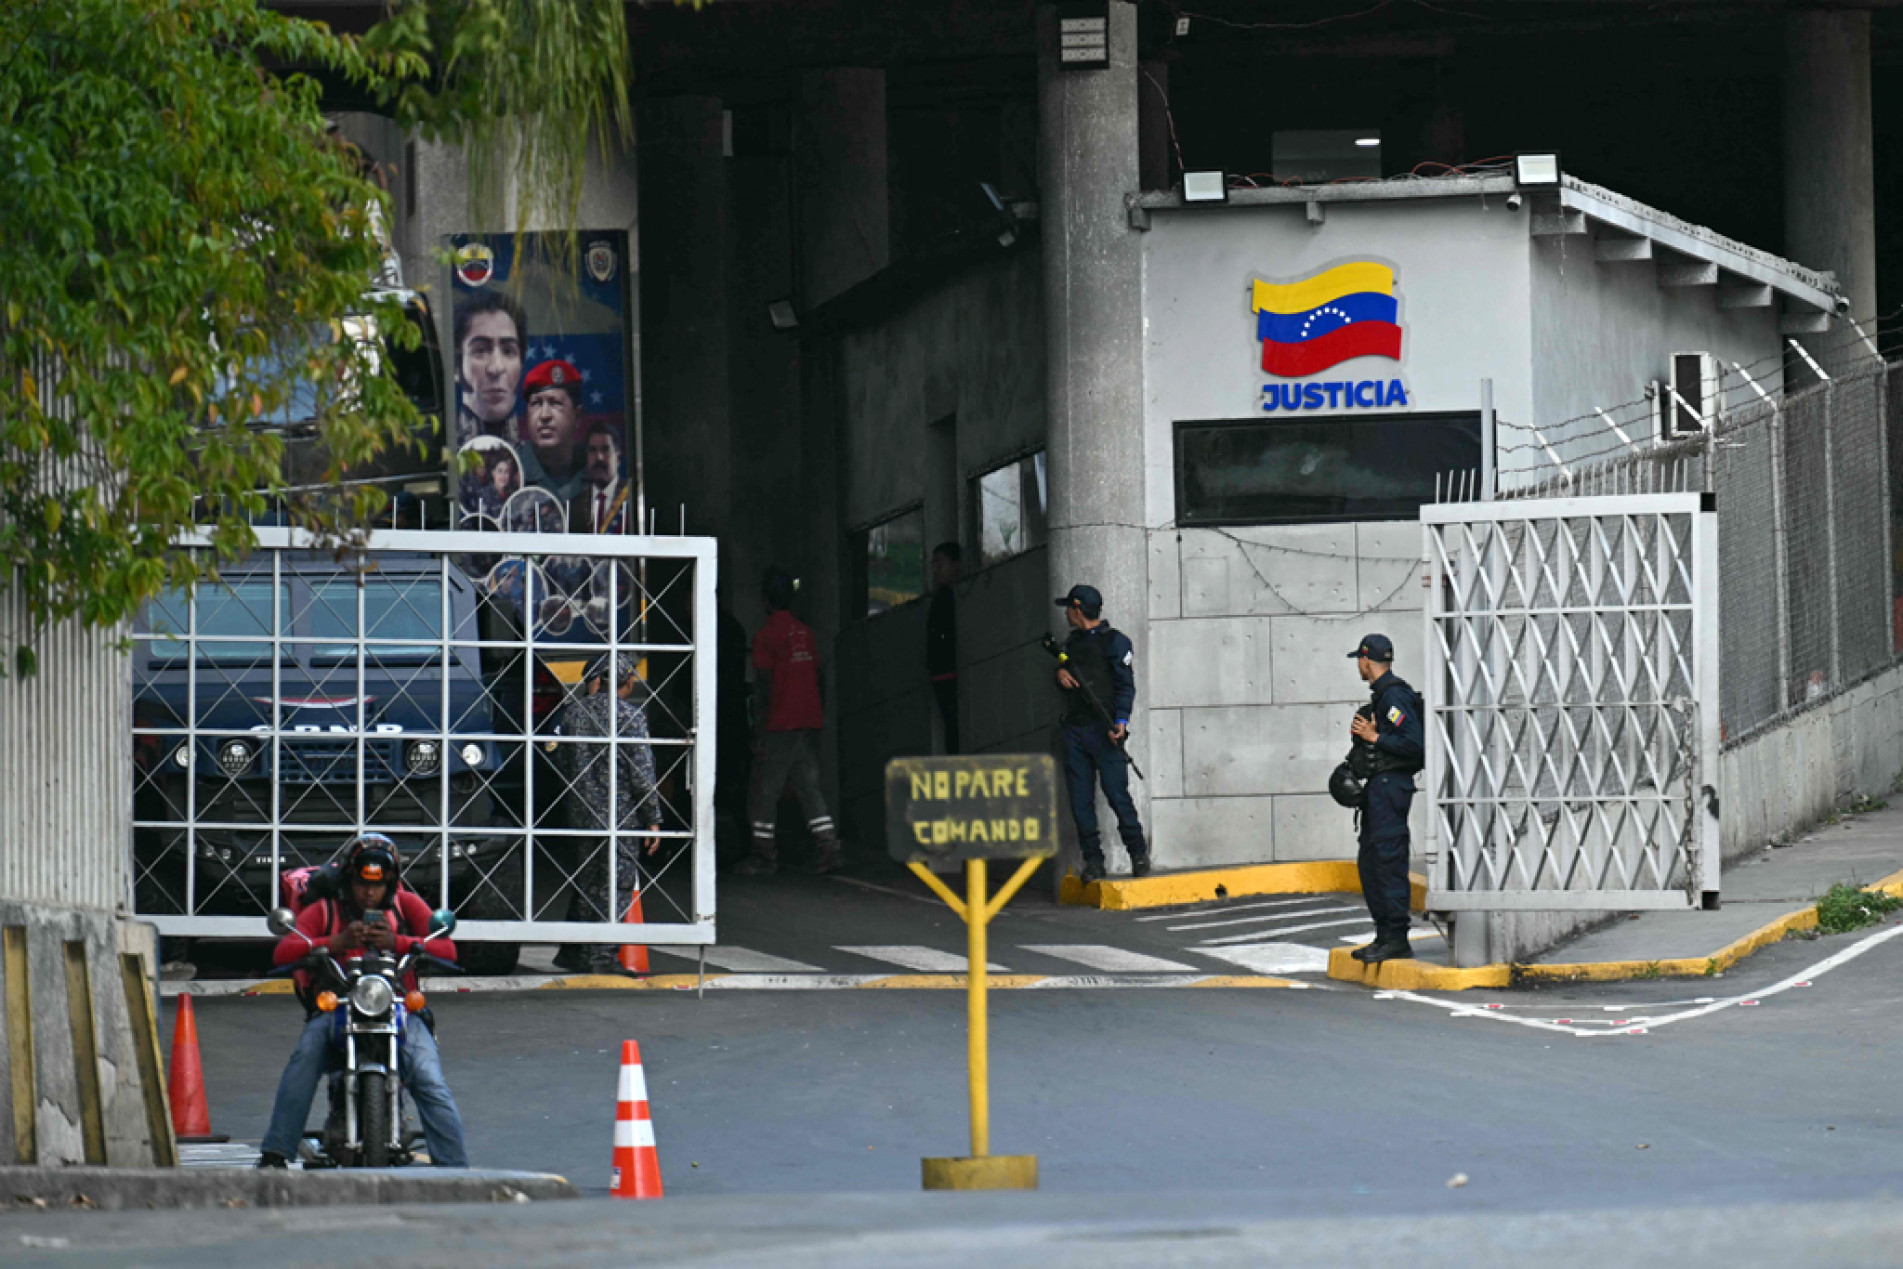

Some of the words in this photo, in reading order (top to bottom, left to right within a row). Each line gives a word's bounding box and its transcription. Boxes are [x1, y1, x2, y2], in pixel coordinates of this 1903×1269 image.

[1263, 380, 1407, 411] JUSTICIA
[911, 771, 950, 800] NO
[956, 768, 1030, 798] PARE
[913, 818, 1039, 843] COMANDO
